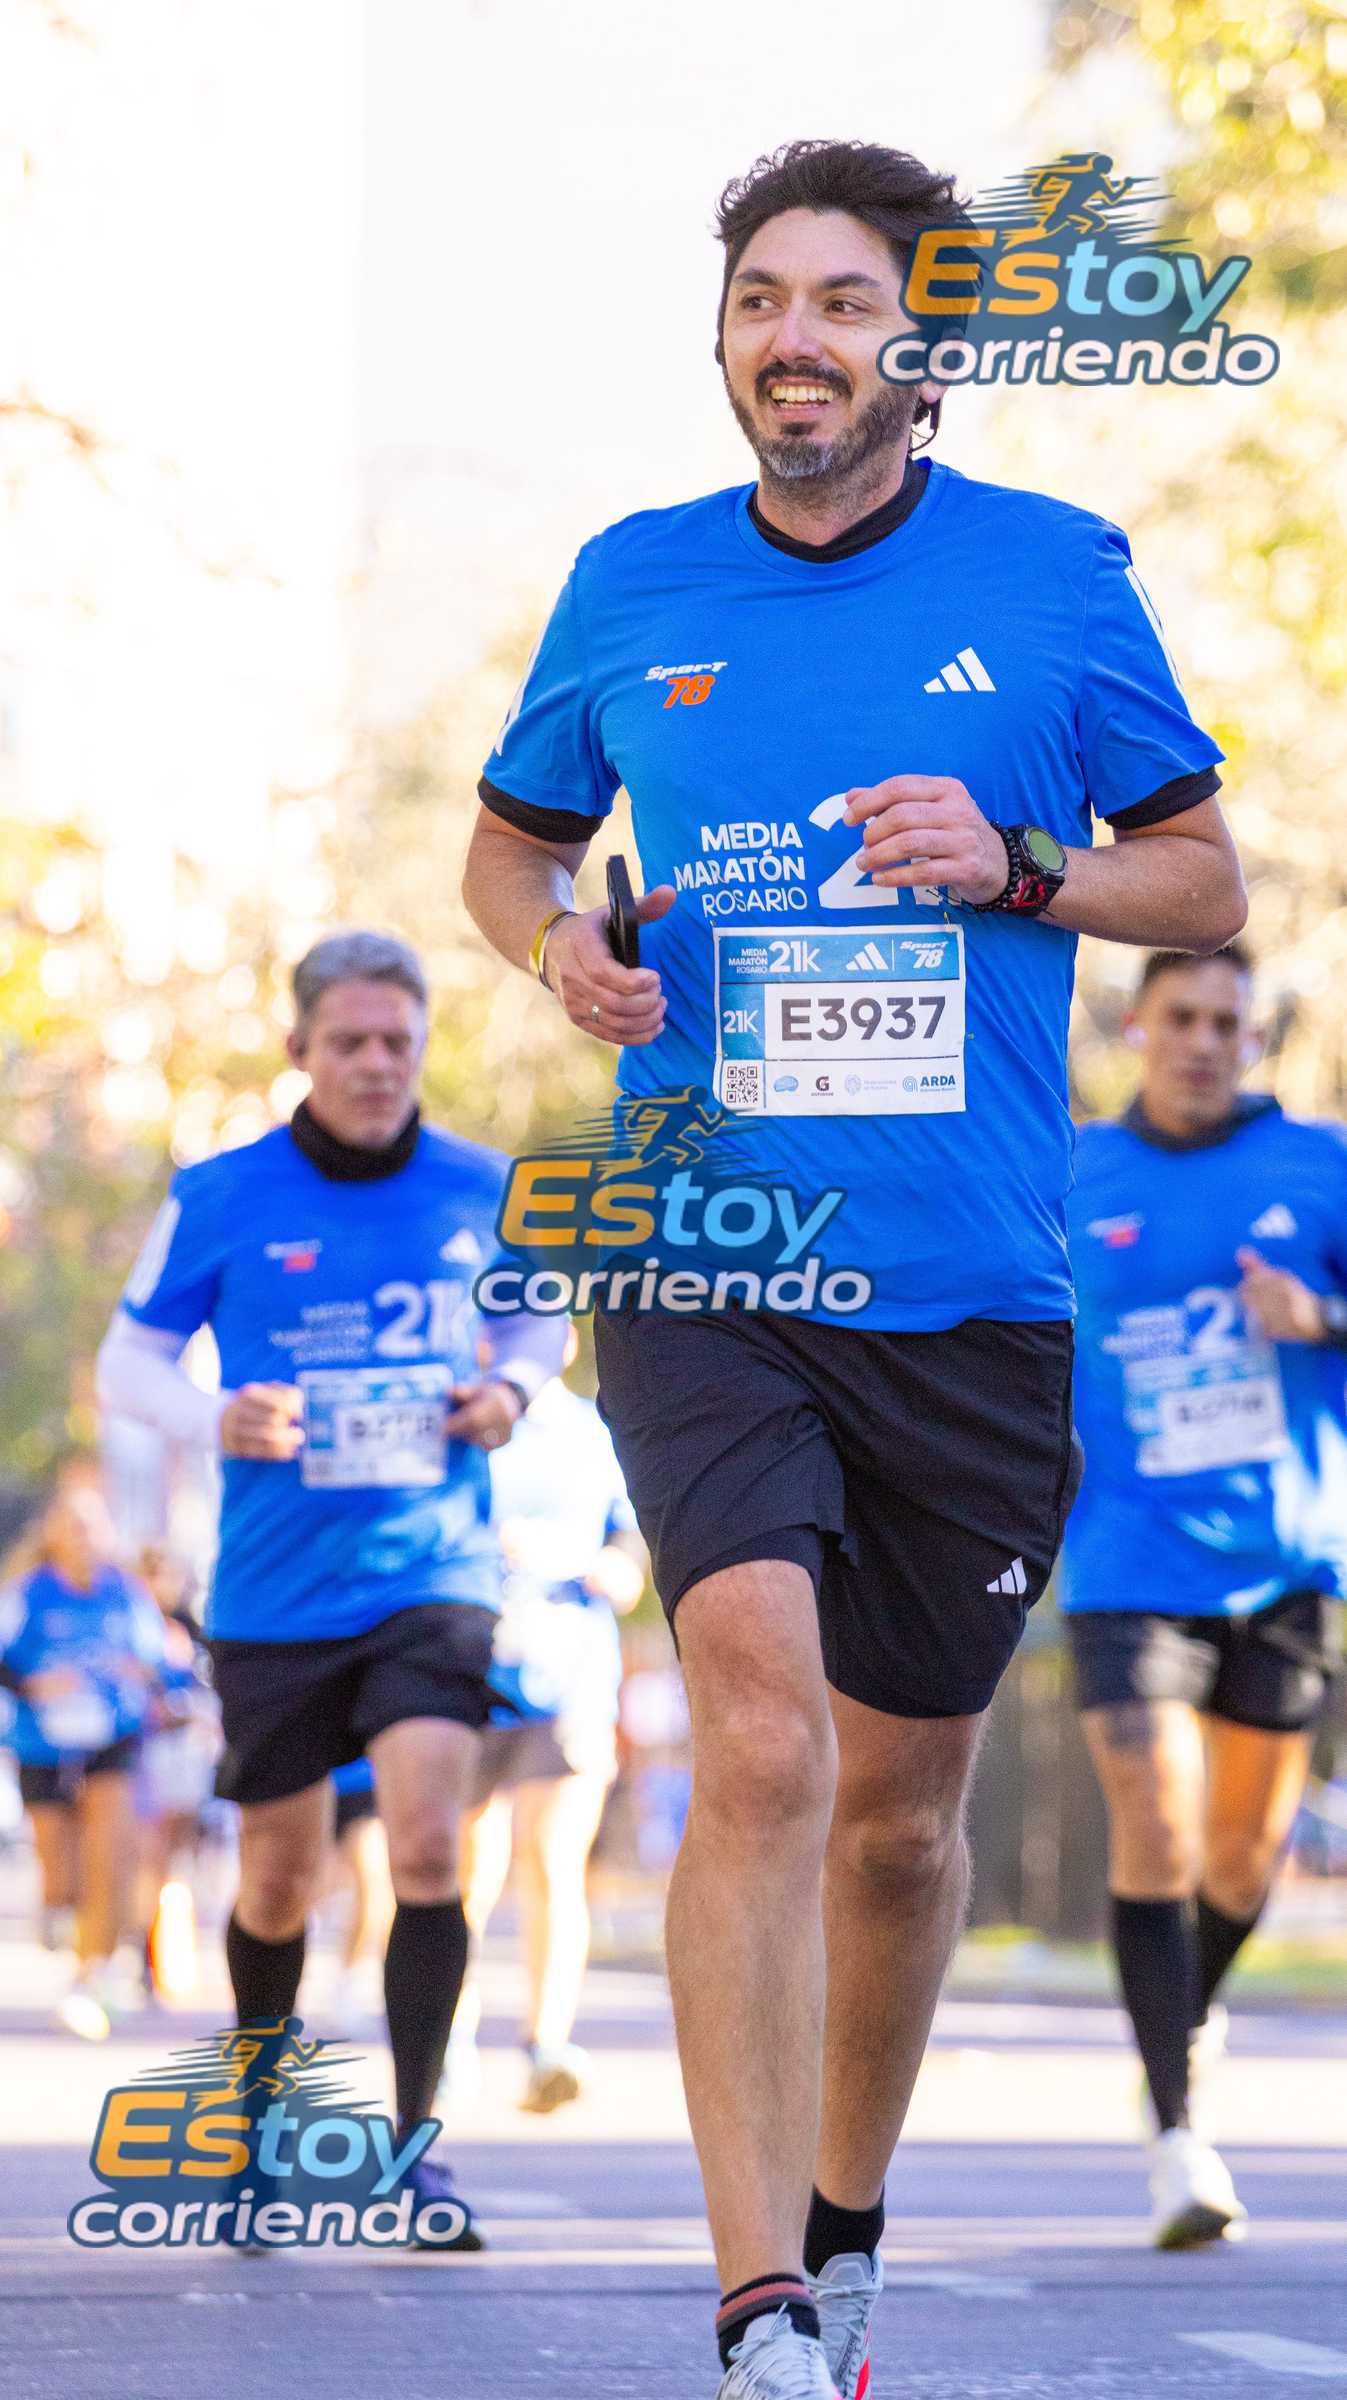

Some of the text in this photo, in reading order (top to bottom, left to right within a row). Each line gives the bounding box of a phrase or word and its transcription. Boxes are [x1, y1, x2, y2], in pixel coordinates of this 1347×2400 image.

[663, 675, 716, 709] 78
[701, 822, 803, 852] MEDIA
[673, 848, 806, 891] MARATÓN
[702, 886, 808, 918] ROSARIO
[728, 956, 768, 967] MARATÓN
[741, 948, 768, 957] MEDIA
[912, 949, 944, 969] 78
[736, 966, 768, 975] ROSARIO
[781, 996, 946, 1041] E3937
[920, 1075, 956, 1087] ARDA
